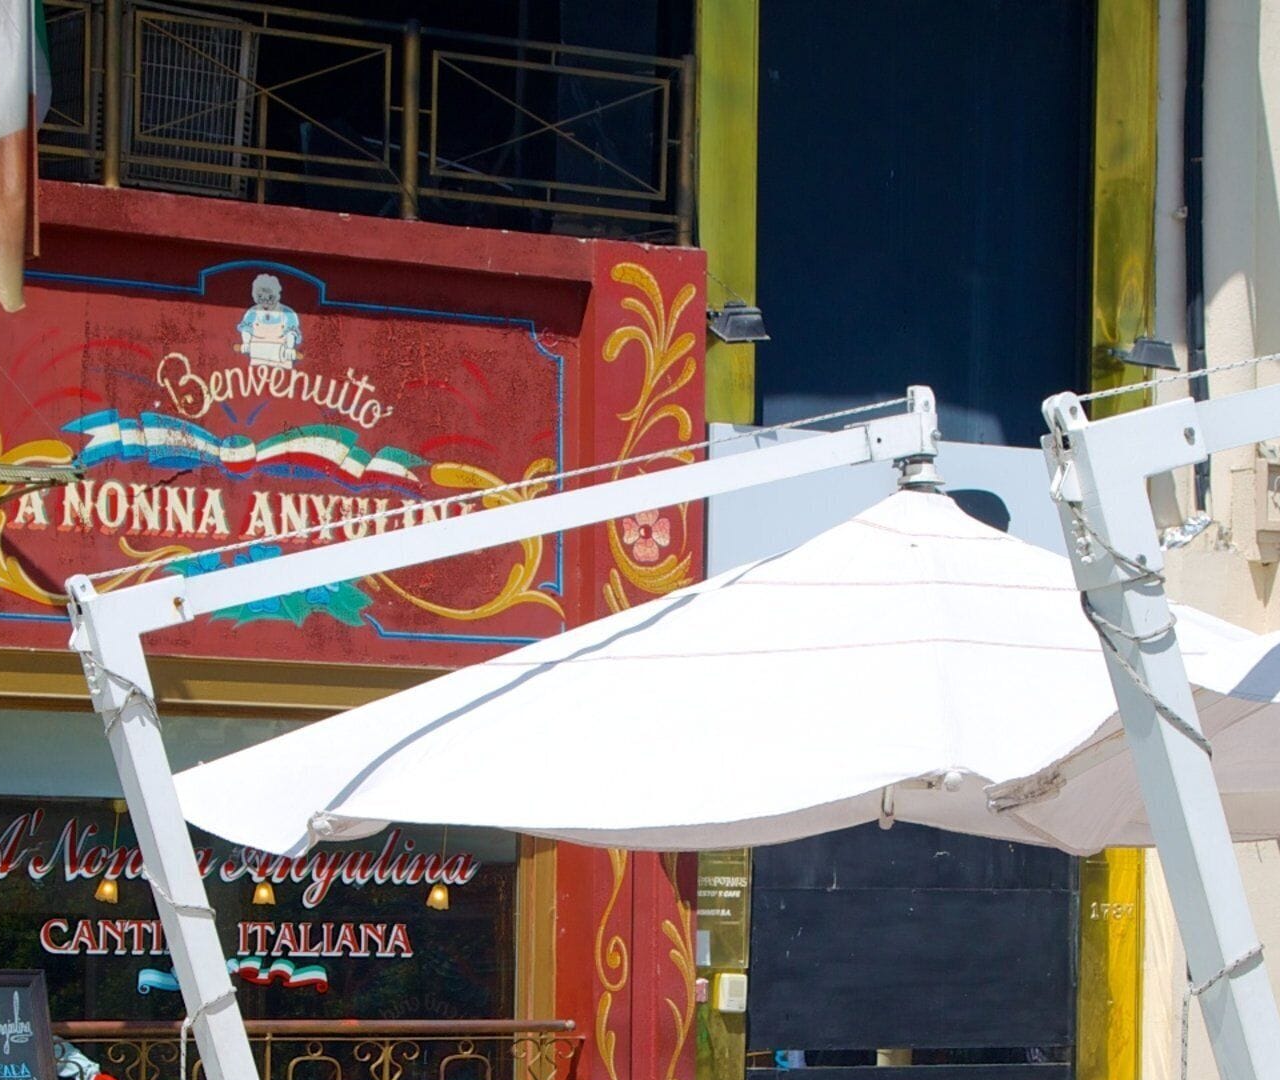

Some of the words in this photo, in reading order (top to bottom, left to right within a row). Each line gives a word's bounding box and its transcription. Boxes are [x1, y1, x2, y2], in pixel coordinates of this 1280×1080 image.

[62, 479, 231, 537] NONNA
[39, 917, 172, 956] CANTI
[236, 919, 415, 958] ITALIANA
